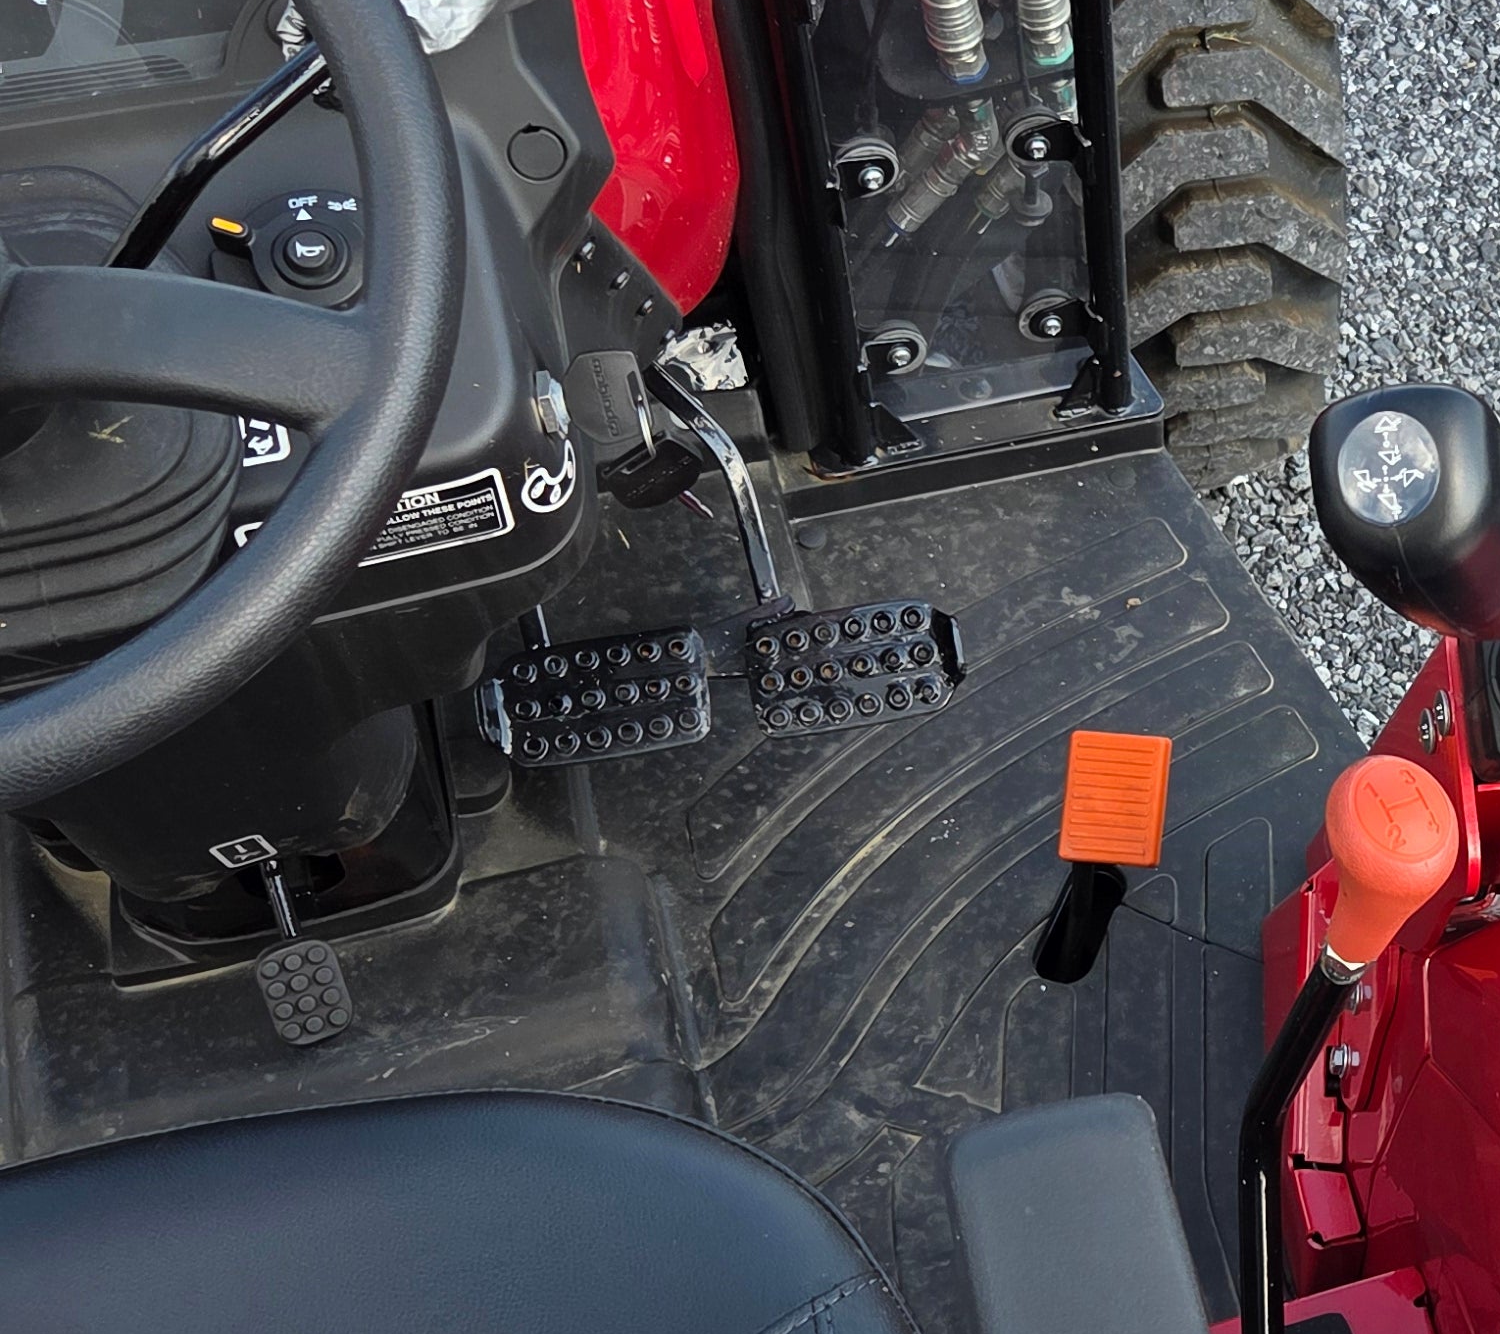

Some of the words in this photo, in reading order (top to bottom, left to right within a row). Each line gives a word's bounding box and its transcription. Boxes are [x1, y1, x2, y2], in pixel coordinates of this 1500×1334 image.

[288, 195, 318, 209] OFF
[397, 492, 441, 510] TION
[421, 504, 456, 517] THESE
[456, 494, 494, 509] POINTS
